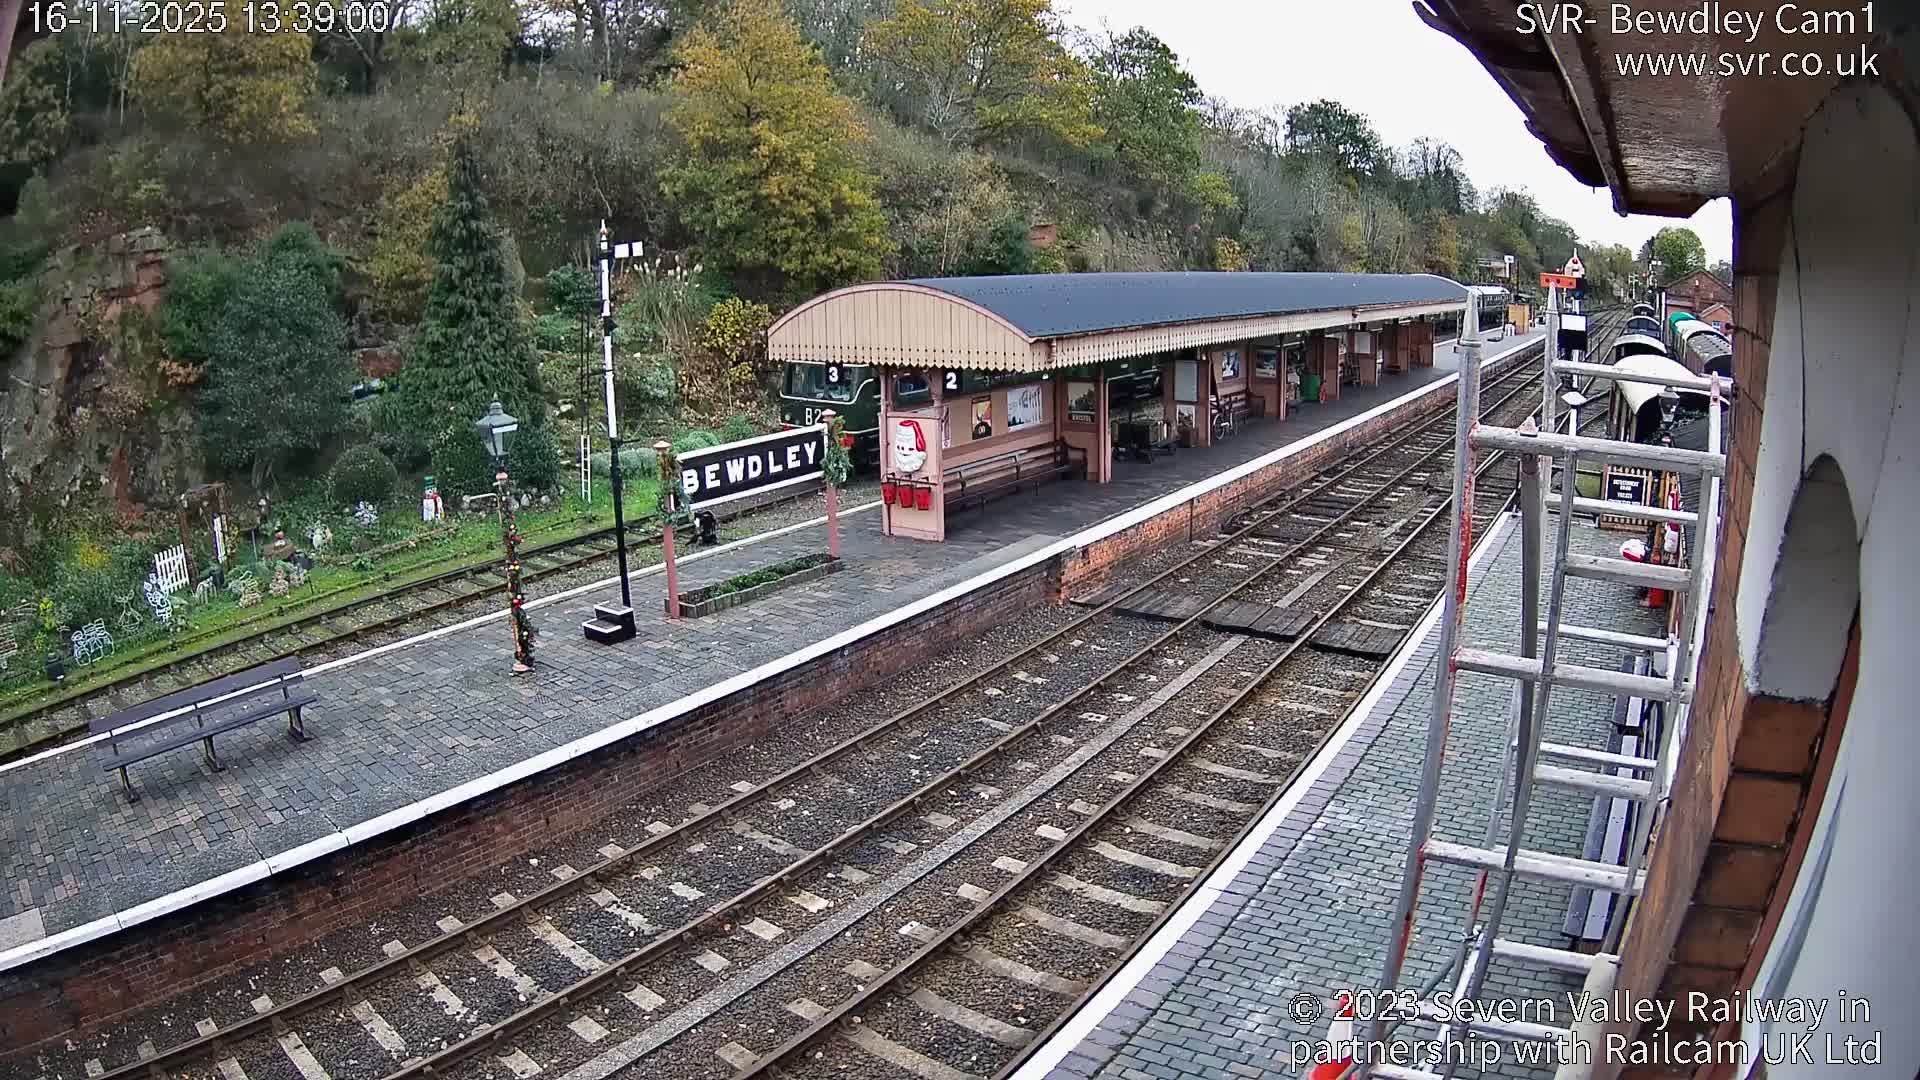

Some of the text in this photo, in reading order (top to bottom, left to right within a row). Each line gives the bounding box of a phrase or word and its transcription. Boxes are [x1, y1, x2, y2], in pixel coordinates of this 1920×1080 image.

[828, 366, 839, 383] 3
[946, 371, 958, 390] 2
[682, 441, 817, 496] BEWDLEY
